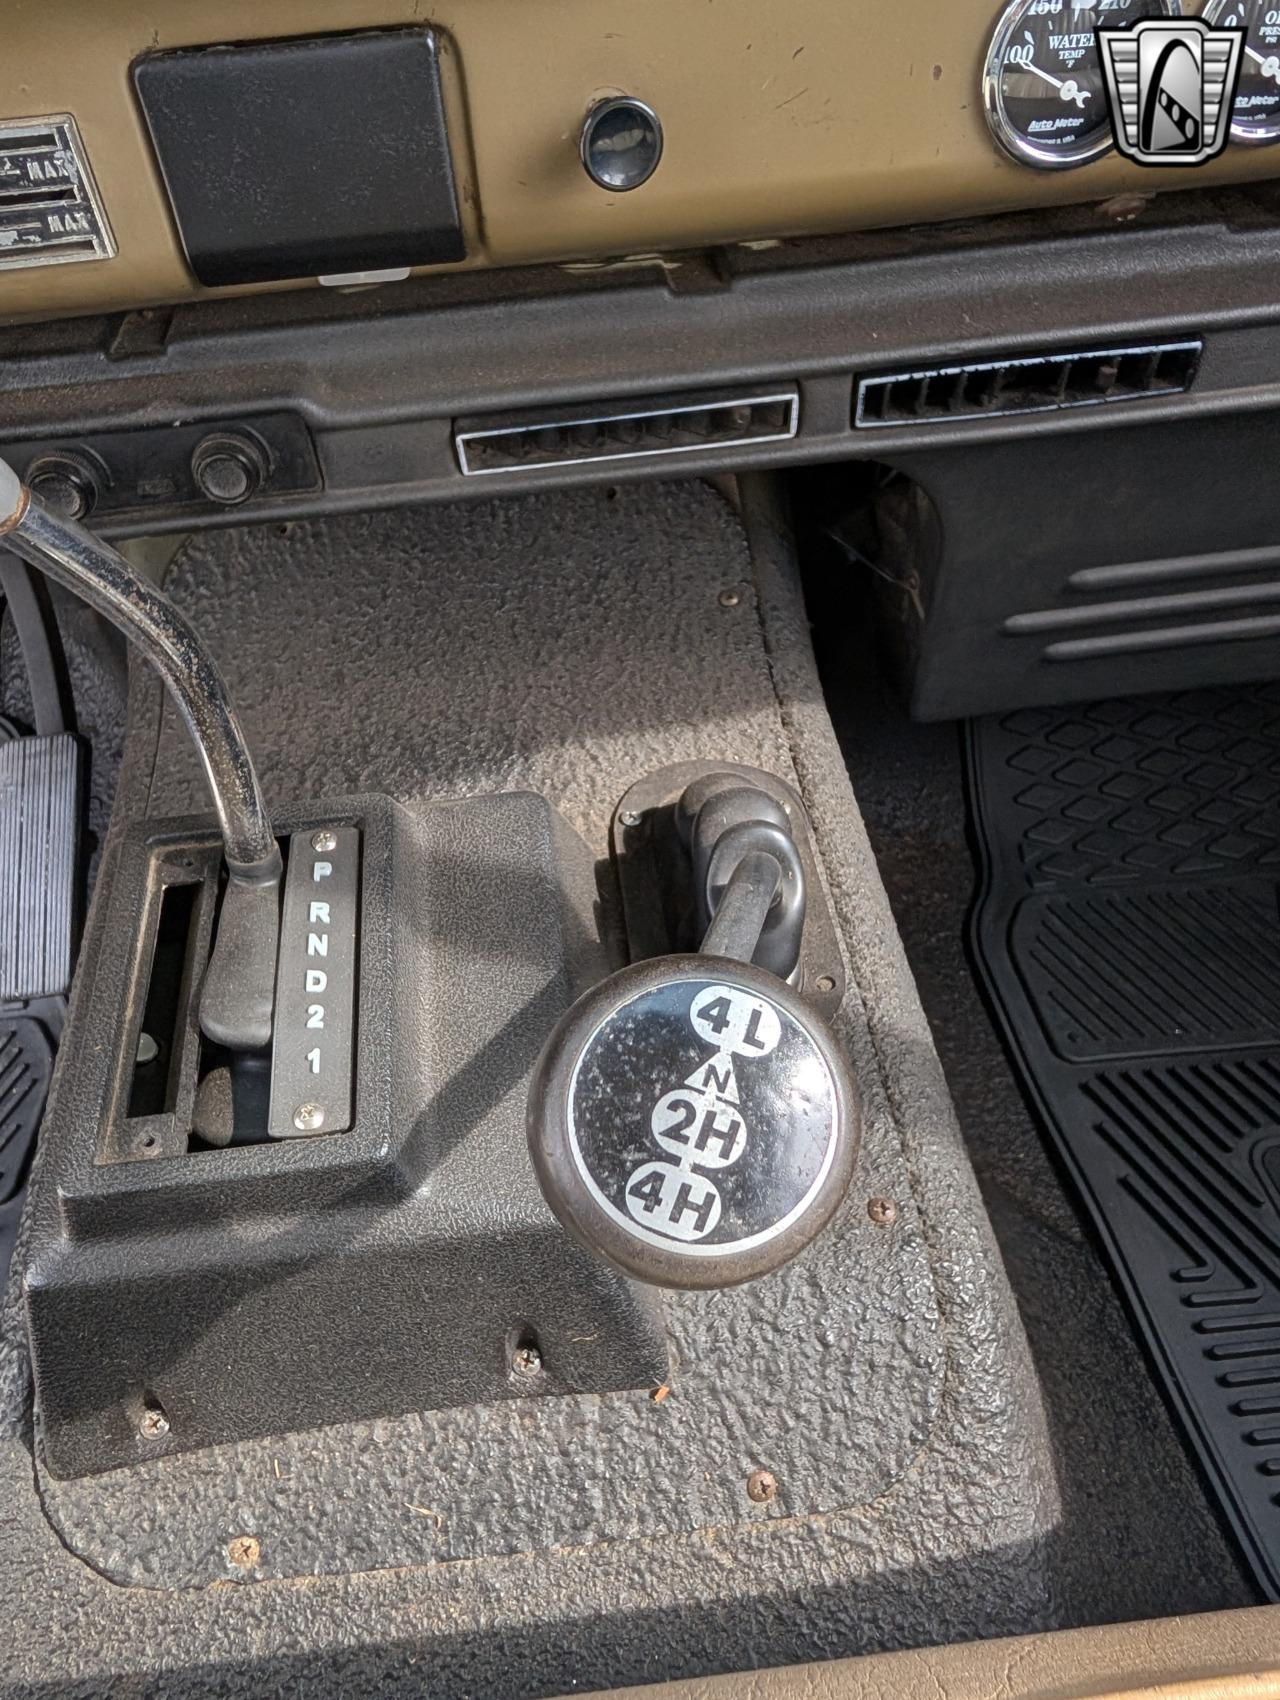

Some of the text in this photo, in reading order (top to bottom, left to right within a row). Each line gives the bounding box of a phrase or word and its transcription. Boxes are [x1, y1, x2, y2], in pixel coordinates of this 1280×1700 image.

[1004, 45, 1034, 64] 100
[1058, 50, 1085, 59] TEMP
[1027, 118, 1084, 132] Auto Meter
[27, 160, 68, 180] MAX
[47, 212, 90, 232] MAX
[313, 862, 332, 882] P
[309, 901, 330, 923] R
[307, 933, 328, 957] N
[305, 970, 328, 993] D
[306, 1004, 324, 1028] 2
[697, 995, 765, 1050] 4L
[307, 1047, 321, 1073] 1
[701, 1063, 732, 1094] N
[658, 1098, 741, 1160] 2H
[628, 1171, 716, 1232] 4H
